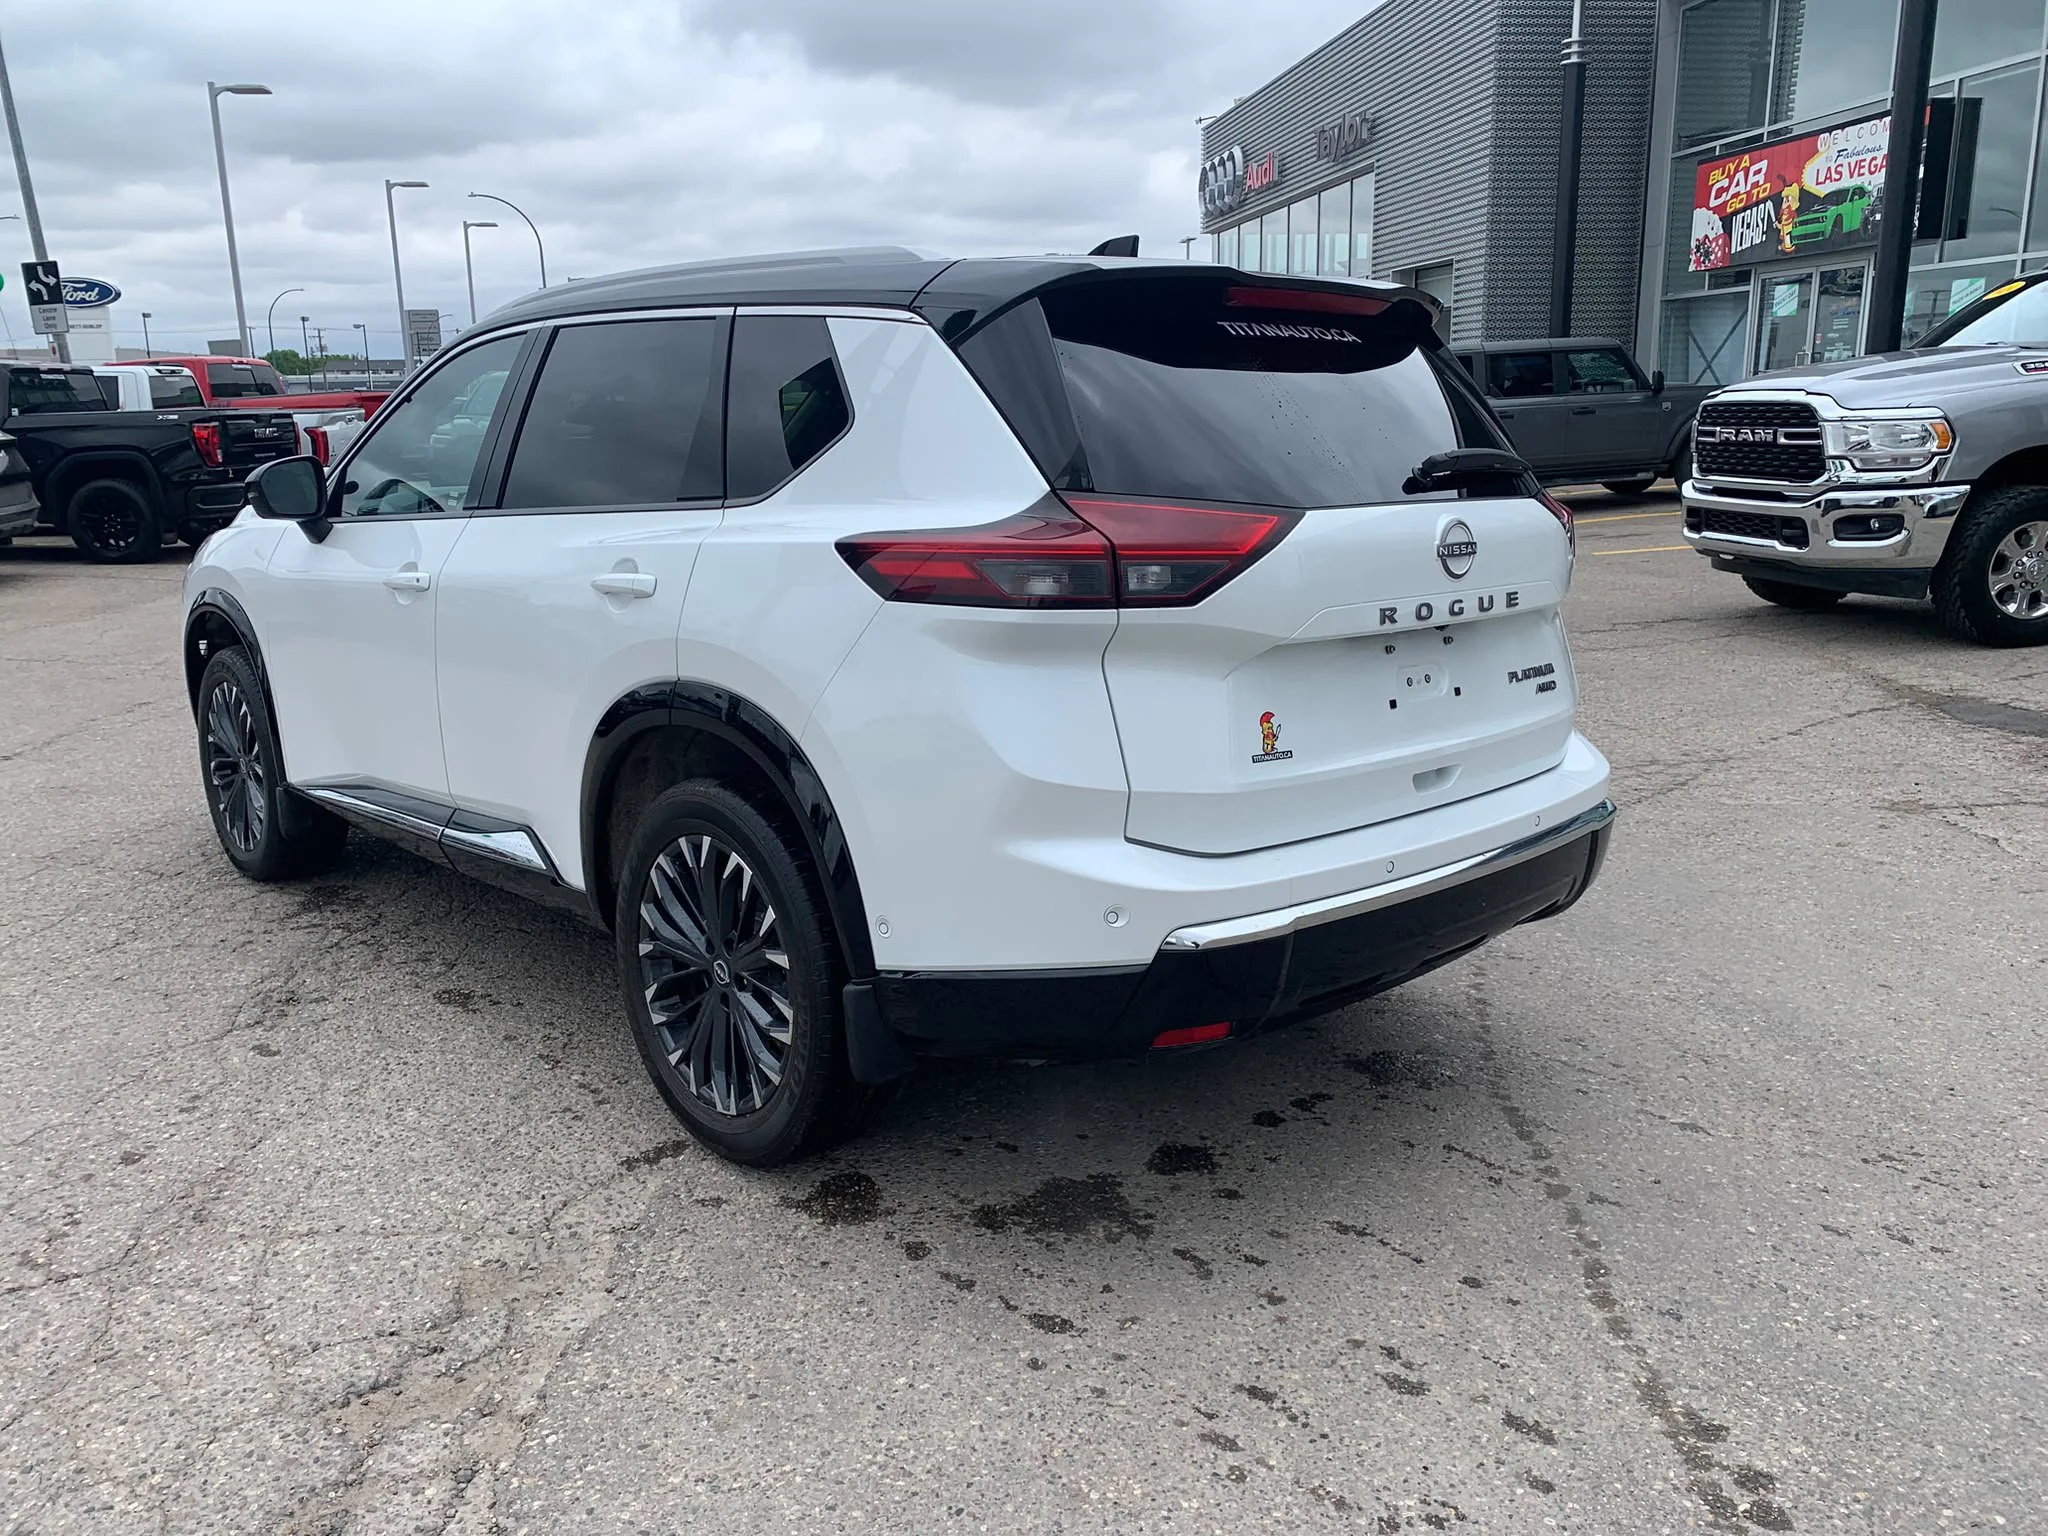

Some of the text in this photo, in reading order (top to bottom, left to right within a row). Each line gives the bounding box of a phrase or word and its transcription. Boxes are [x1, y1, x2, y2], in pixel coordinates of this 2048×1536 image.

[1314, 112, 1371, 162] Taylor
[1820, 121, 1892, 148] WELCOM
[1835, 145, 1884, 163] Fabulous
[1245, 152, 1276, 192] Audi
[1708, 154, 1750, 185] BUY A
[1815, 154, 1888, 186] LAS VEGA
[1709, 159, 1768, 208] CAR
[1727, 183, 1771, 213] GO TO
[1731, 200, 1768, 254] VEGAS!
[61, 282, 99, 301] Ford
[1216, 321, 1362, 344] TITANAUTO.CA
[1720, 429, 1774, 442] RAM
[1439, 544, 1477, 556] NISSAN
[1379, 591, 1520, 626] ROGUE
[1507, 662, 1555, 684] PLATINUM
[1535, 680, 1557, 694] AWD
[1253, 751, 1292, 762] TITANAUTO.CA
